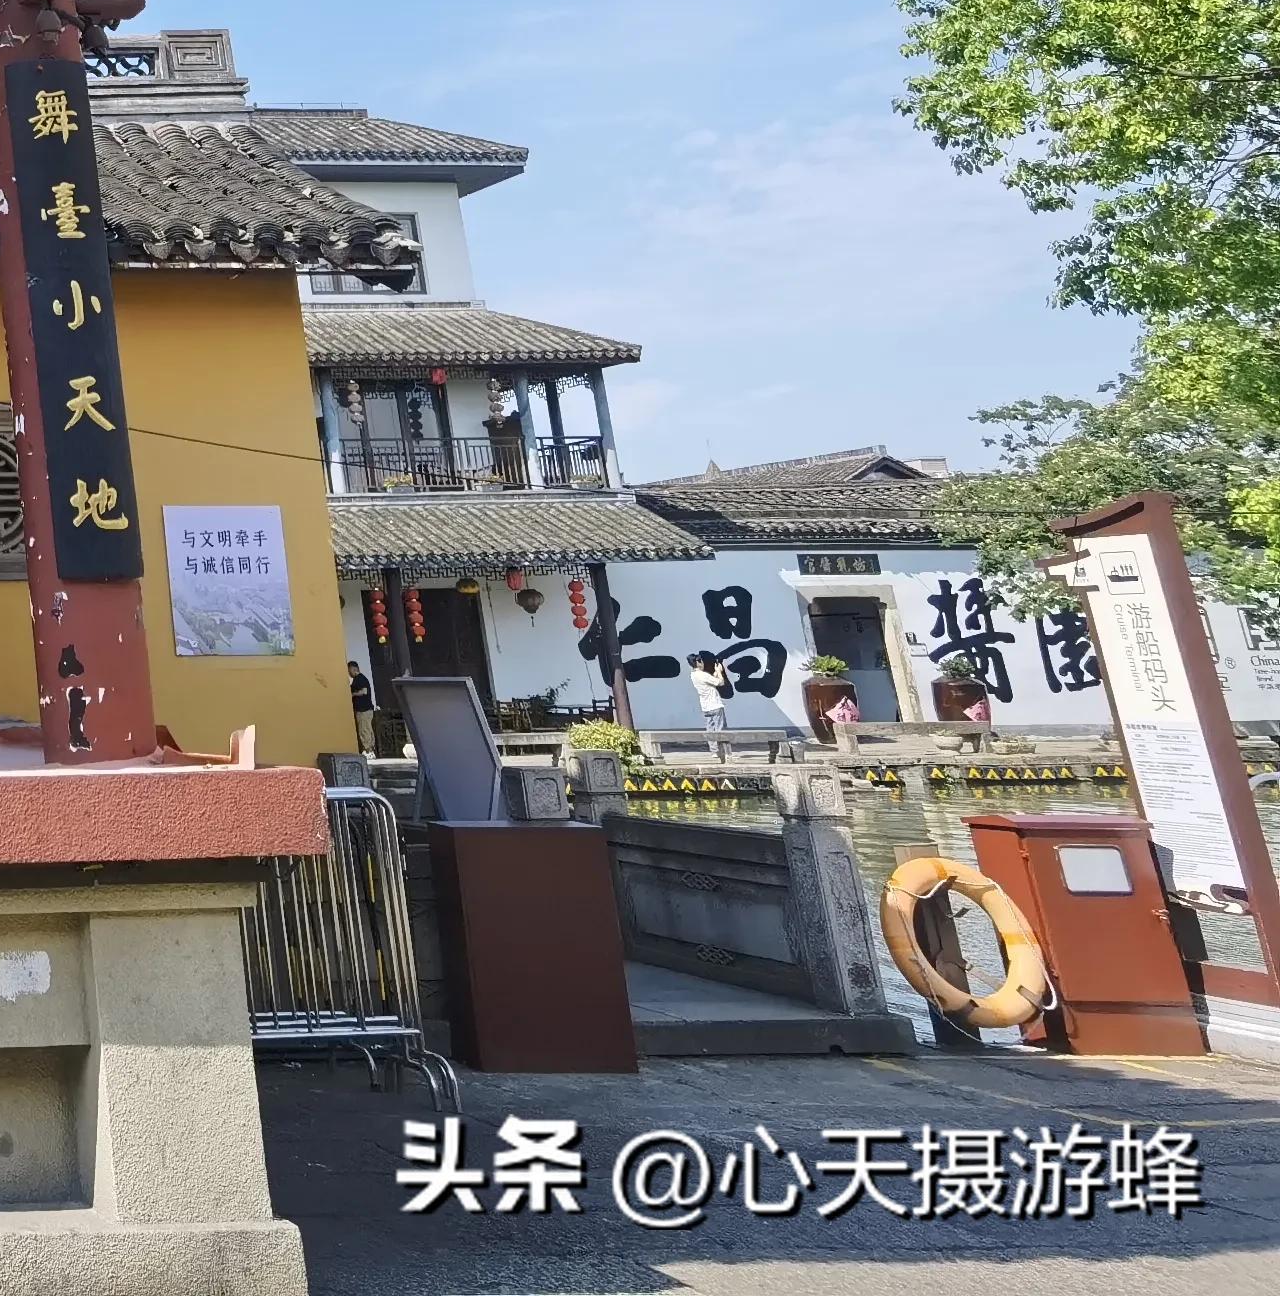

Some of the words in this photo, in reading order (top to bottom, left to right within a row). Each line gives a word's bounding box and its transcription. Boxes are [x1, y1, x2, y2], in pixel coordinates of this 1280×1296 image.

[28, 90, 128, 530] 舞臺小天地
[181, 529, 268, 549] 与文明牵手
[184, 556, 272, 575] 与诚信同行
[1113, 603, 1129, 641] Cruise
[1125, 643, 1144, 693] Terminal
[1126, 602, 1177, 713] 游船码头
